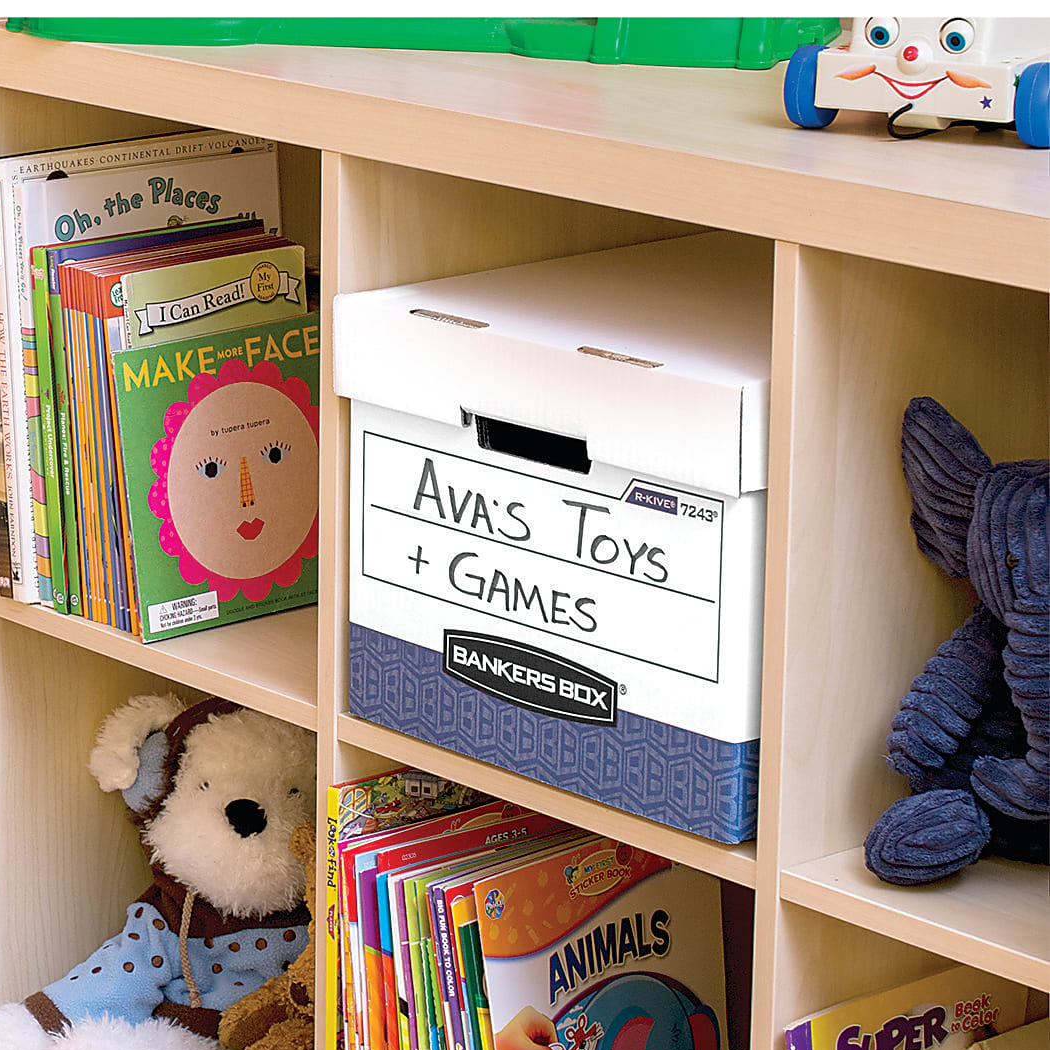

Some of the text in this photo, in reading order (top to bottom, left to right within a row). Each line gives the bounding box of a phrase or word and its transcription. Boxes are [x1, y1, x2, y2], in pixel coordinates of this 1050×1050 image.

[20, 158, 95, 174] EARTHQUAKES
[100, 149, 170, 164] CONTINENTAL
[176, 143, 203, 155] DRIFT
[54, 176, 222, 242] Oh, the Places
[257, 282, 275, 293] First
[258, 272, 271, 282] My
[159, 281, 246, 322] I Can Read!
[0, 351, 8, 377] THE
[122, 346, 217, 392] MAKE
[217, 345, 243, 360] MORE
[0, 382, 11, 426] EARTH
[210, 418, 271, 437] by tupera tupera
[4, 432, 14, 480] WORKS
[414, 457, 532, 542] AVA'S
[448, 552, 599, 634] GAMES
[453, 643, 610, 711] BANKERS BOX
[485, 827, 528, 845] AGES 3-5
[569, 866, 632, 899] STICKER BOOK
[436, 899, 456, 997] BIG FUN BOOK TO COLOR
[549, 908, 671, 1006] ANIMALS
[951, 1008, 999, 1032] to Color
[955, 993, 991, 1018] Book
